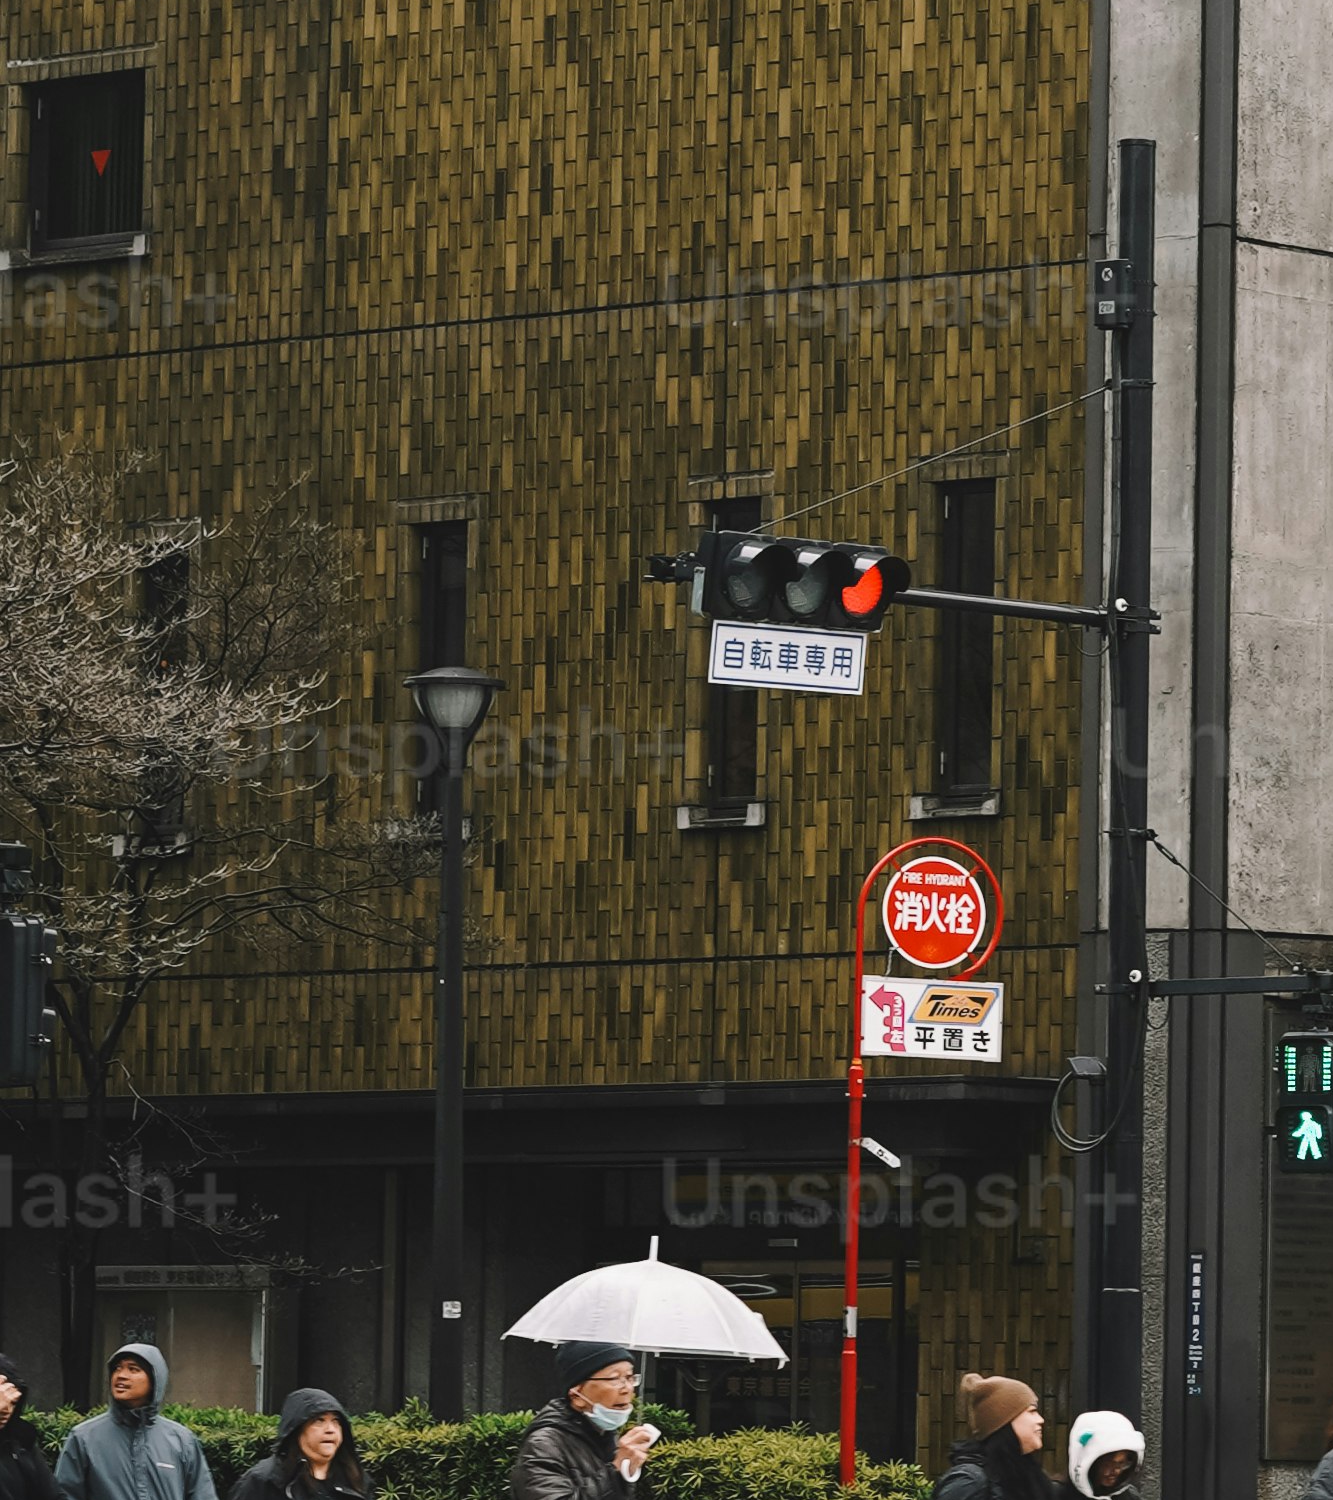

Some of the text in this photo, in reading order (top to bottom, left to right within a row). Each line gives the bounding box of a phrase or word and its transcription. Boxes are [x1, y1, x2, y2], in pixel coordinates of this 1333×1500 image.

[722, 636, 854, 679] 自転車専用
[902, 871, 968, 887] FIRE HYDRANT
[893, 890, 975, 935] 消火栓
[927, 995, 984, 1018] Times
[914, 1026, 991, 1052] 平置き
